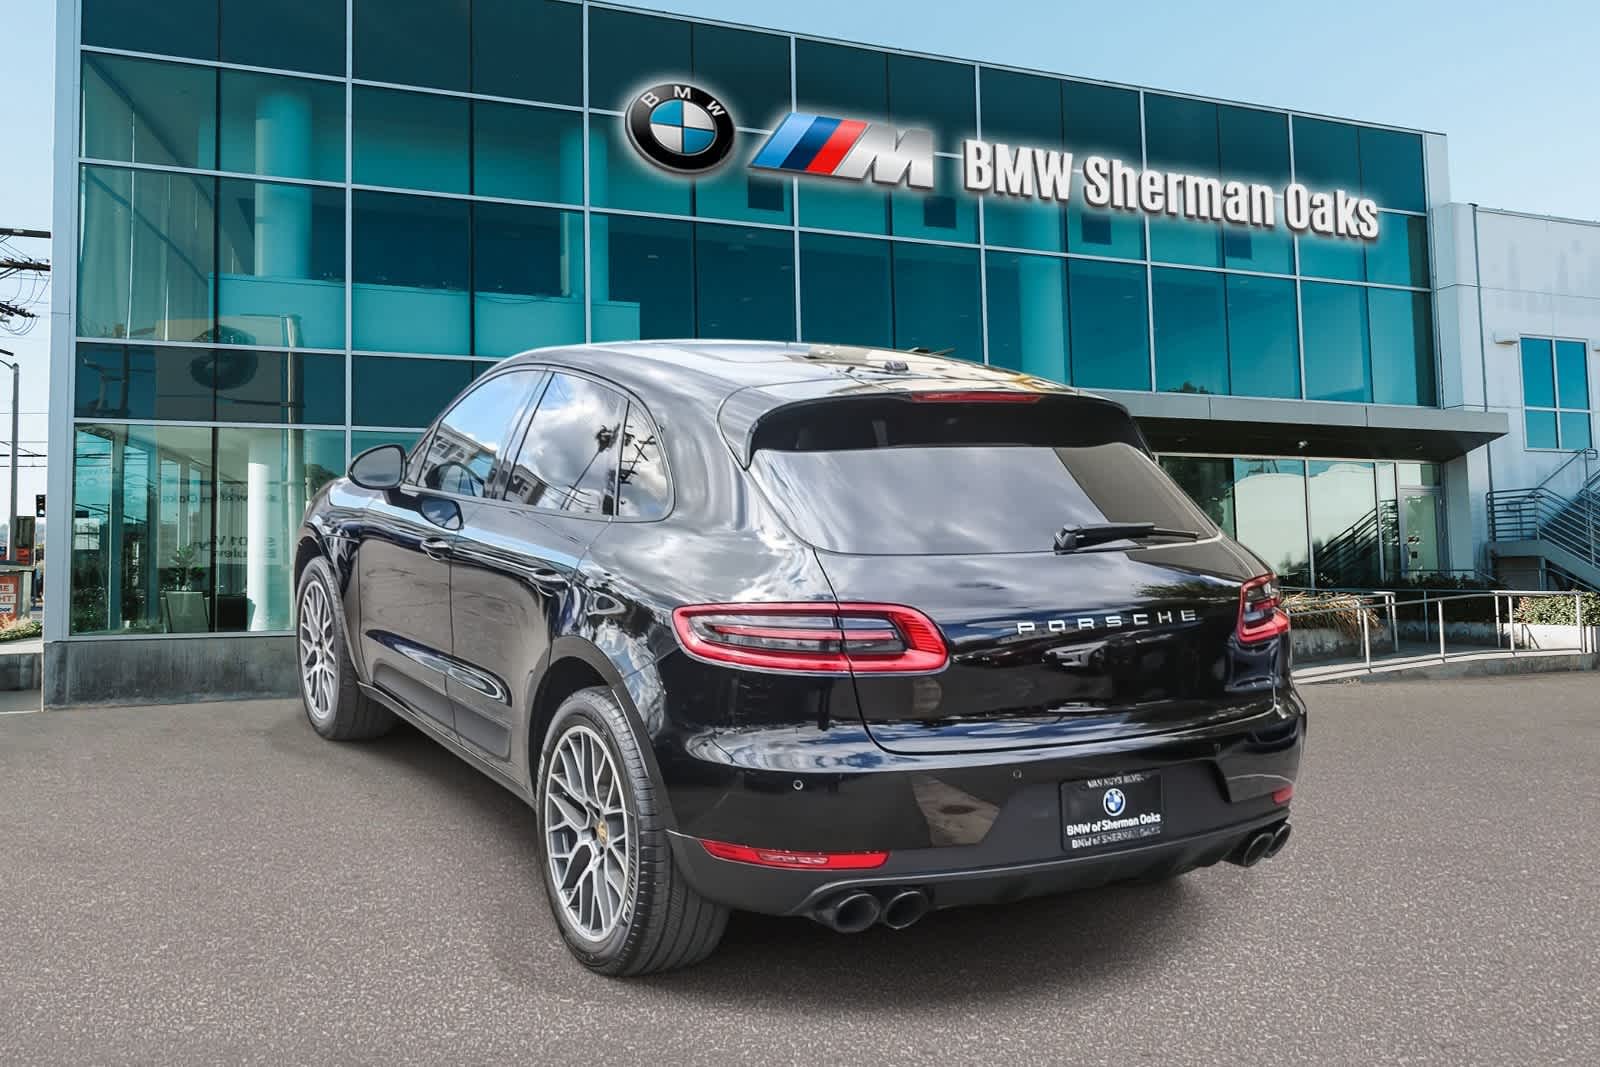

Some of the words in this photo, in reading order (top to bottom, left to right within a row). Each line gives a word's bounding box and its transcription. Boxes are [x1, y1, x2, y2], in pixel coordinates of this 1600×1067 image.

[641, 85, 725, 117] BMW
[963, 139, 1073, 201] BMW
[1083, 156, 1274, 227] Sherman
[1284, 183, 1380, 240] Oaks
[1017, 609, 1197, 635] PORSCHE
[1066, 823, 1090, 836] BMW
[1091, 820, 1101, 832] of
[1102, 816, 1139, 831] Sherman
[1139, 812, 1161, 825] Oaks
